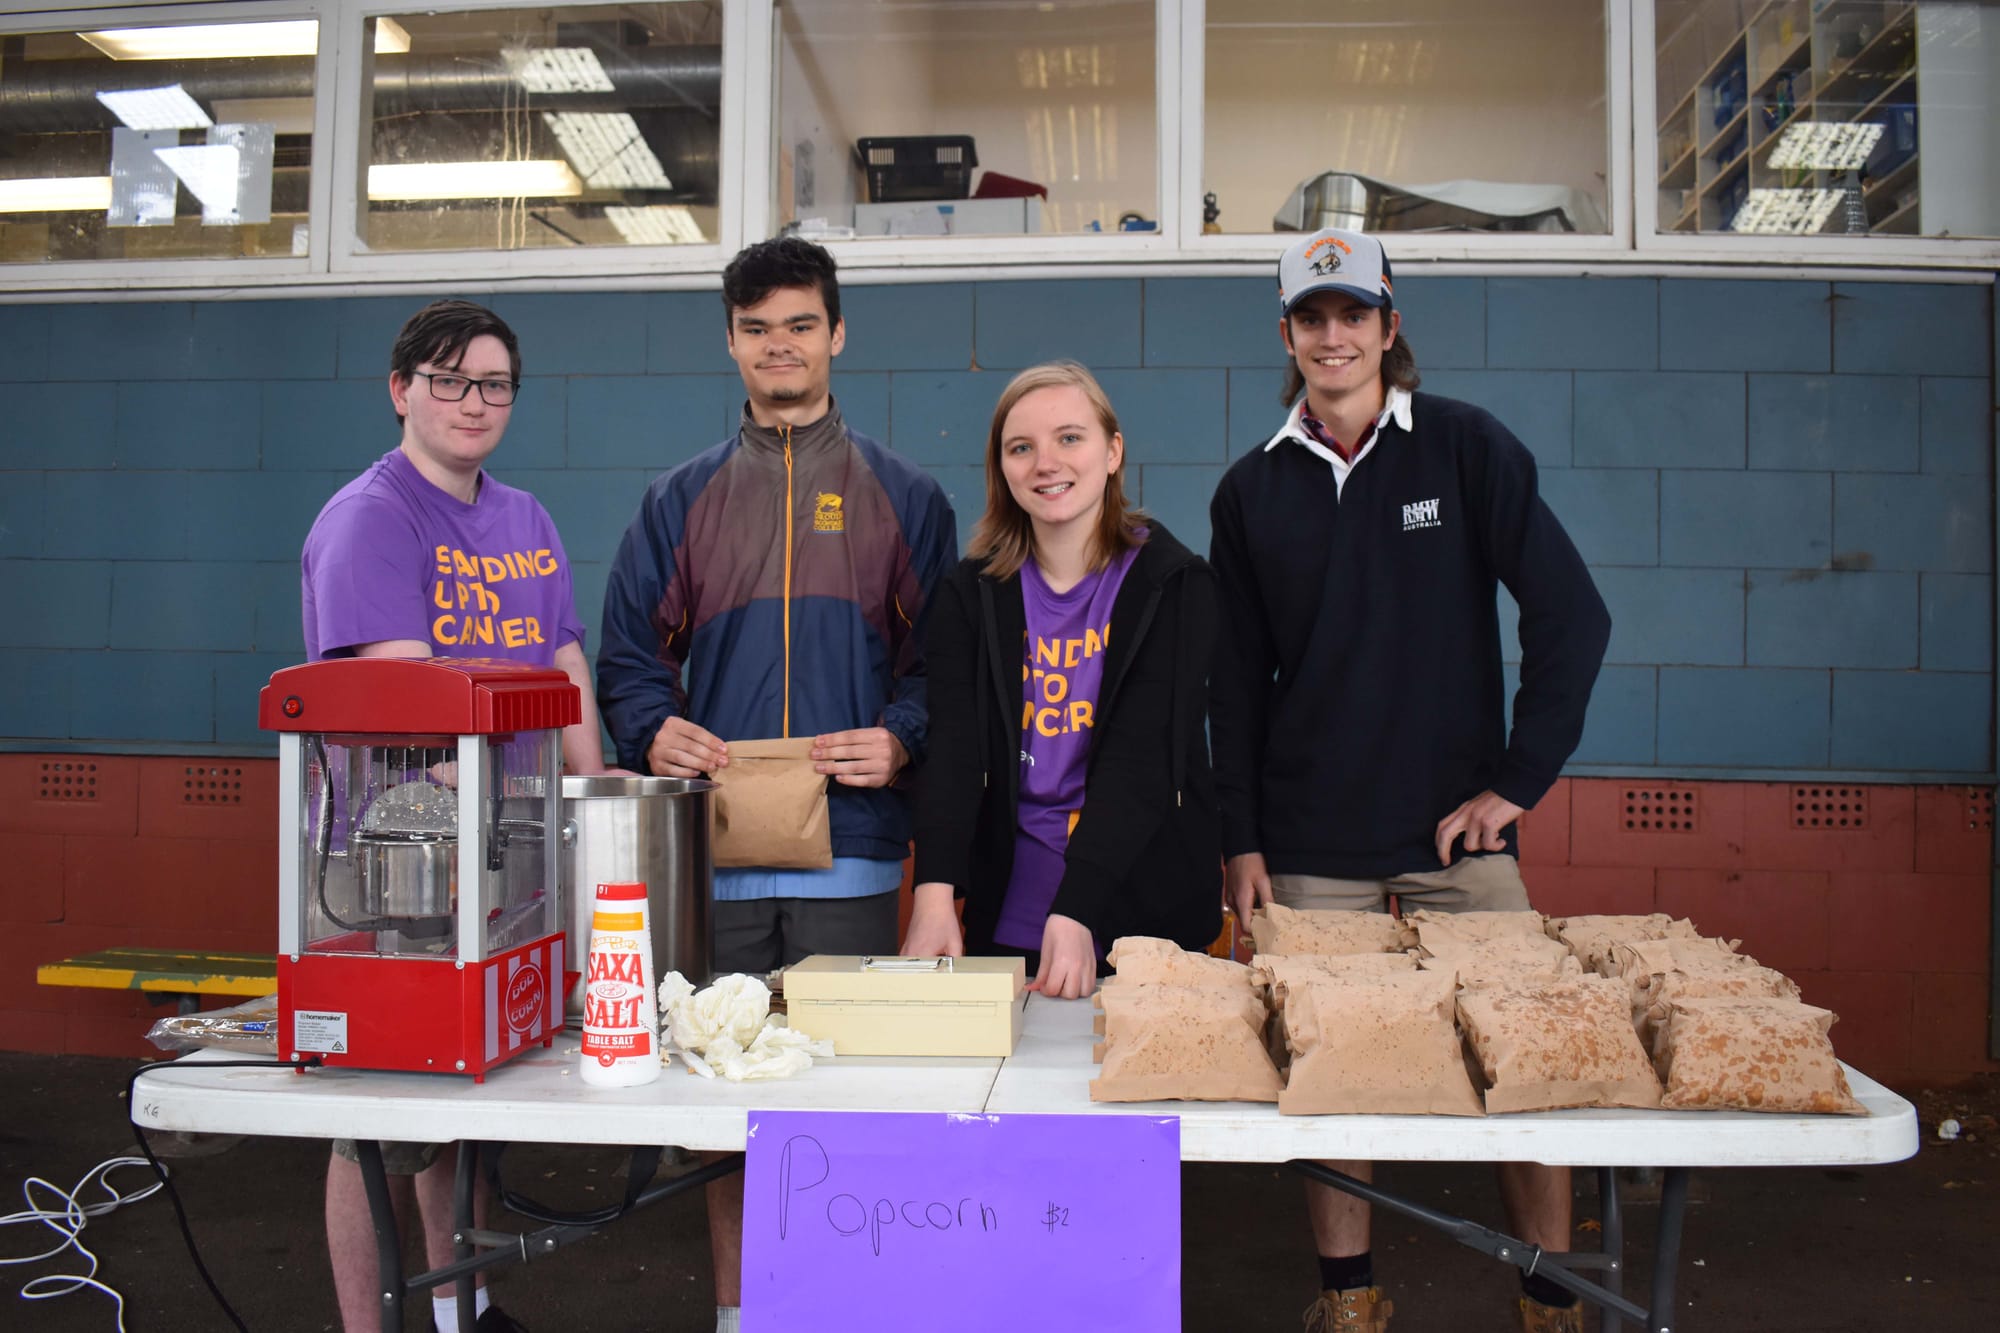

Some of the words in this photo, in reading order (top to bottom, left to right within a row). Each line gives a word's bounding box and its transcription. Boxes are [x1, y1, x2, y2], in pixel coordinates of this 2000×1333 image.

[1403, 520, 1441, 531] AUSTRALIA
[432, 614, 545, 648] CANER
[588, 952, 644, 988] SAXA
[584, 992, 644, 1028] SALT
[587, 1034, 610, 1045] TABLE
[611, 1035, 635, 1045] SALT
[779, 1134, 997, 1257] Popcorn
[1041, 1201, 1070, 1234] $2
